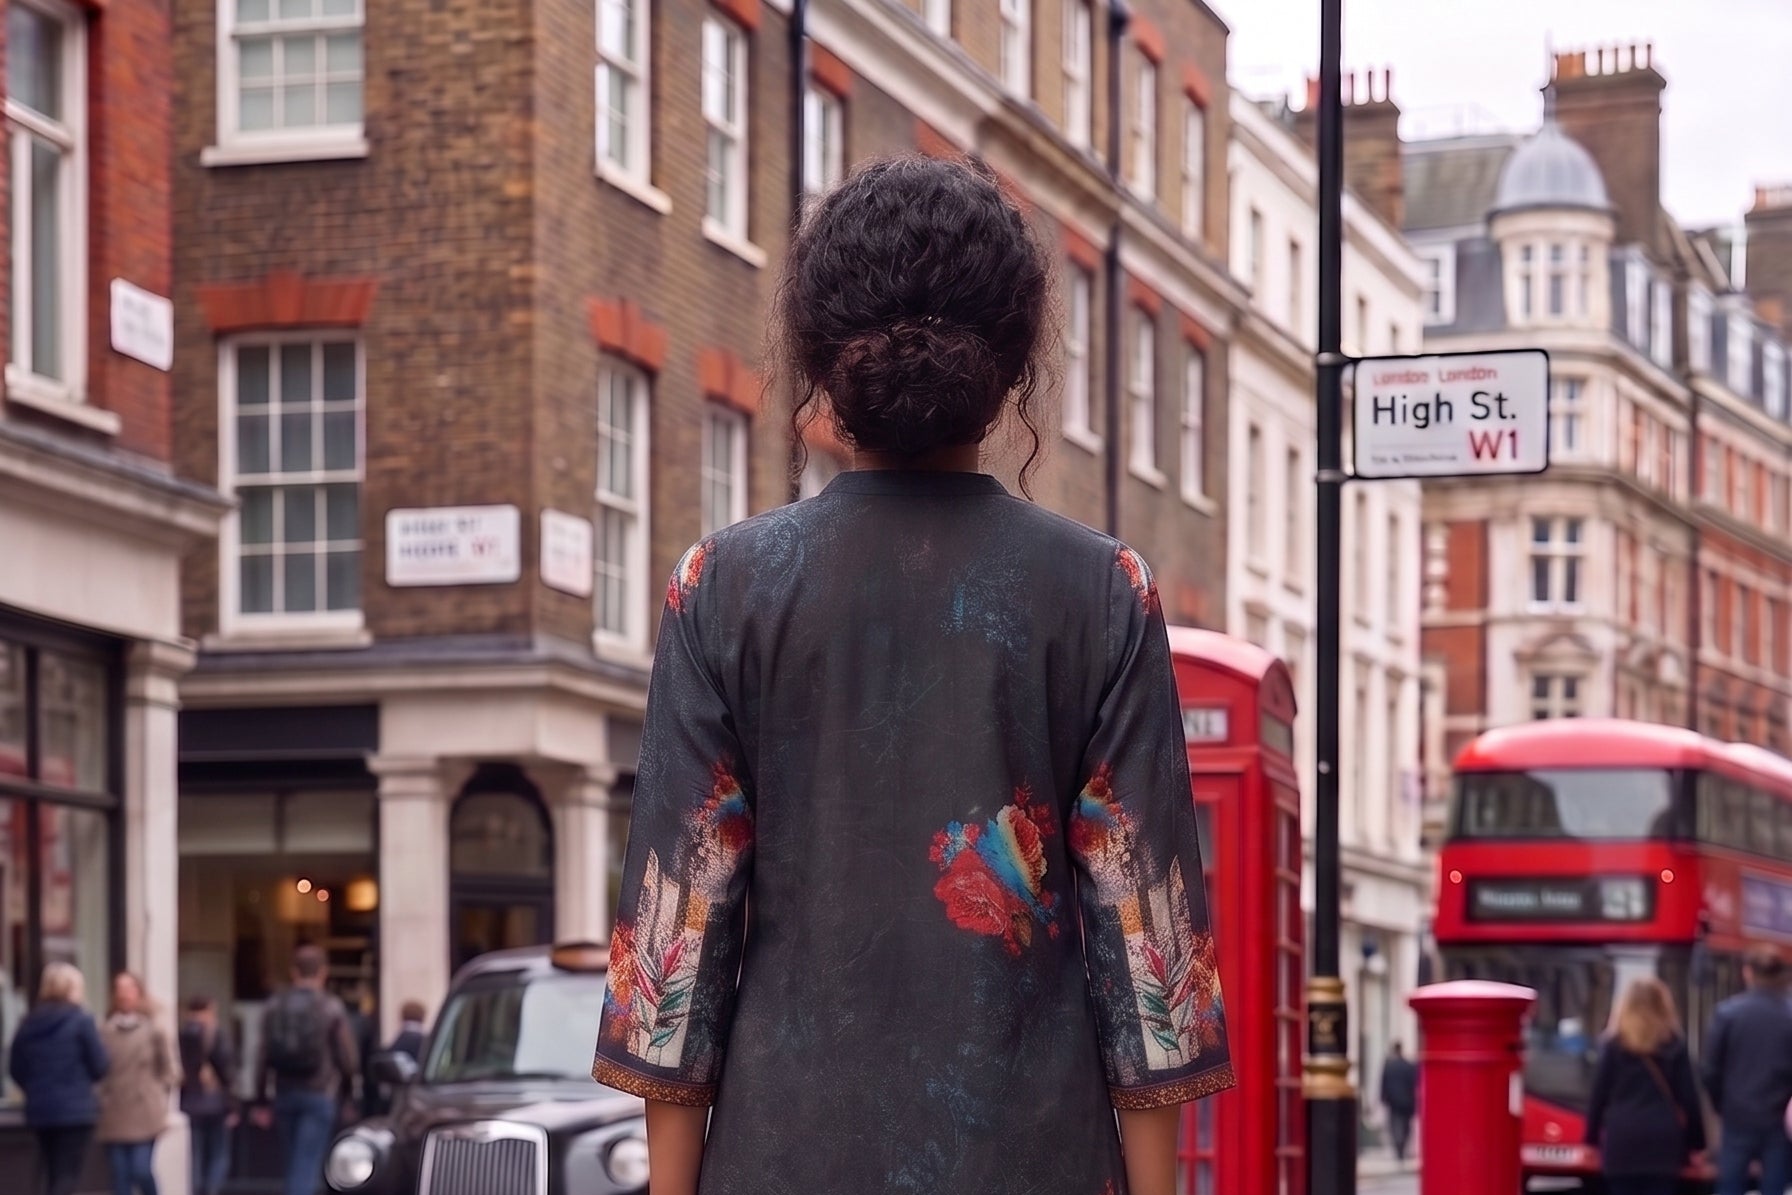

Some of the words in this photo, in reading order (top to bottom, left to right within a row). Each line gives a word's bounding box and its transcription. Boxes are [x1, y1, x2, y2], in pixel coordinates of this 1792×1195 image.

[1372, 393, 1453, 429] High
[1470, 391, 1517, 420] St.
[1469, 430, 1518, 460] W1
